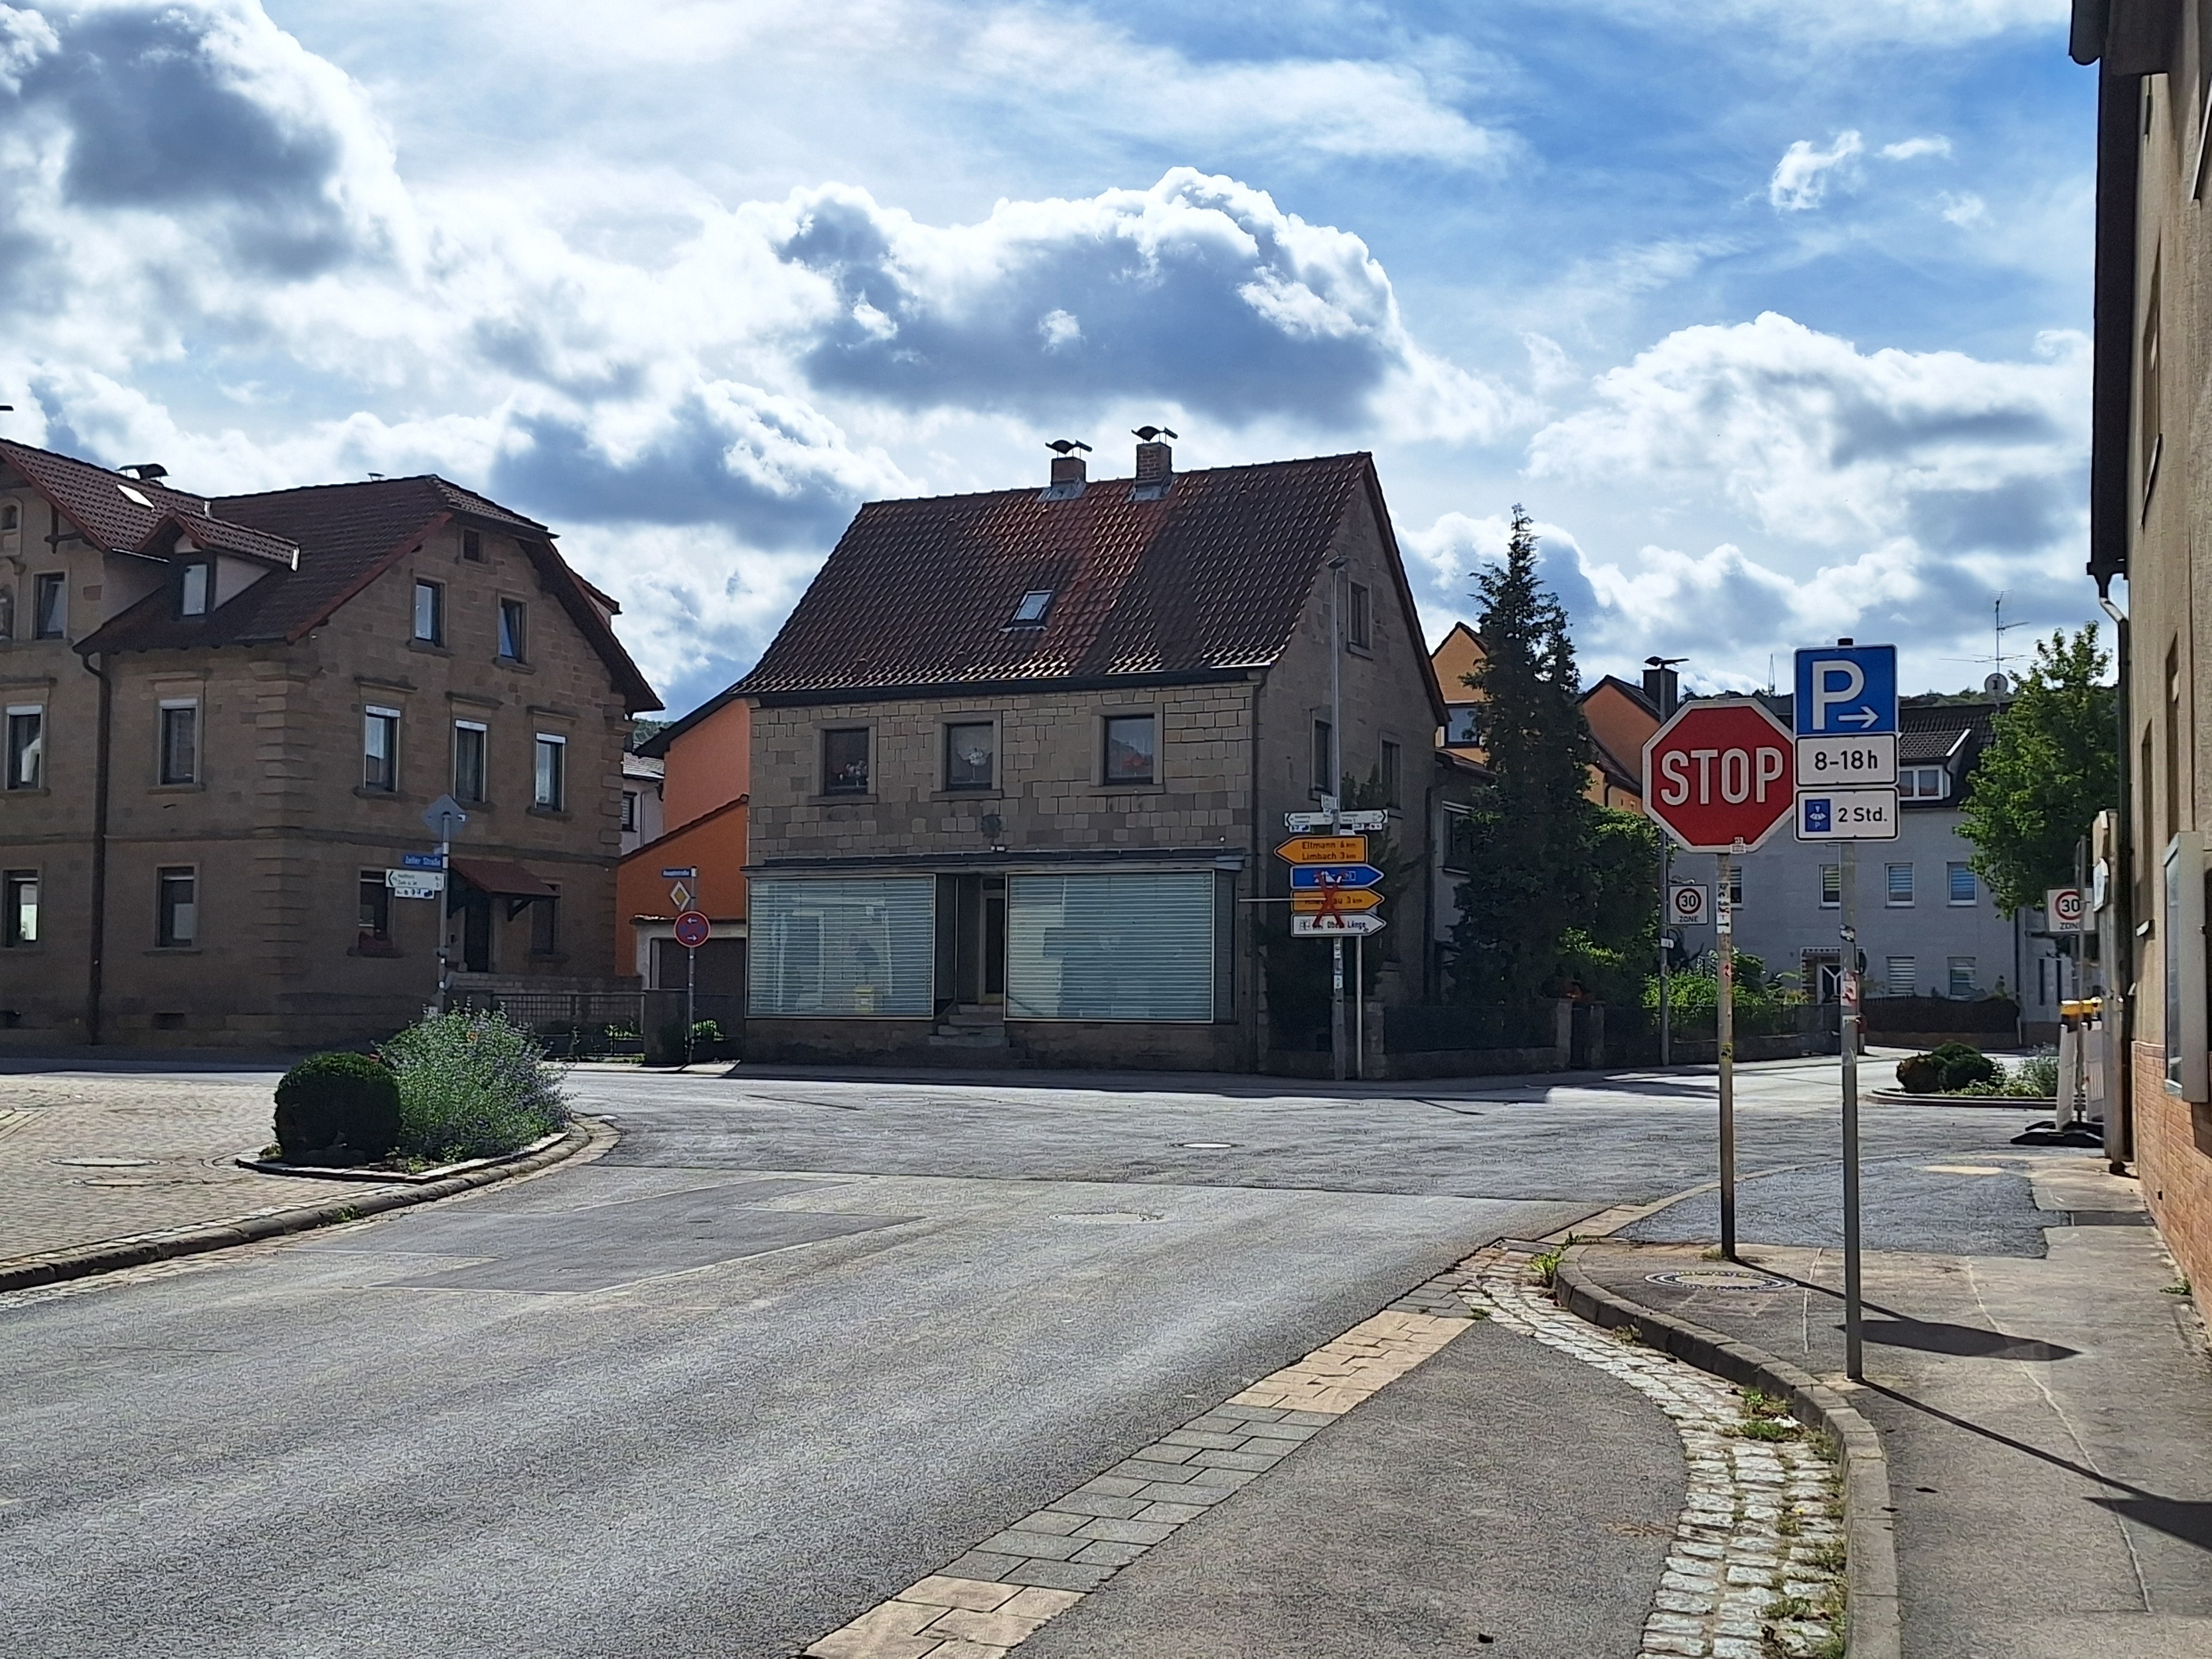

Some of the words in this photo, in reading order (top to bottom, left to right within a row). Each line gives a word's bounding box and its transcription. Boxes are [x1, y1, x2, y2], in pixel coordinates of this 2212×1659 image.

[1812, 660, 1864, 730] P
[1661, 747, 1784, 806] STOP
[1838, 807, 1848, 822] 2
[1853, 806, 1888, 822] Std.
[1302, 841, 1336, 850] Eltmann
[1340, 840, 1345, 848] 6
[1302, 852, 1337, 860] Limbach
[1340, 852, 1345, 860] 3
[1681, 895, 1696, 908] 30
[2061, 899, 2080, 912] 30
[2060, 922, 2079, 930] ZON
